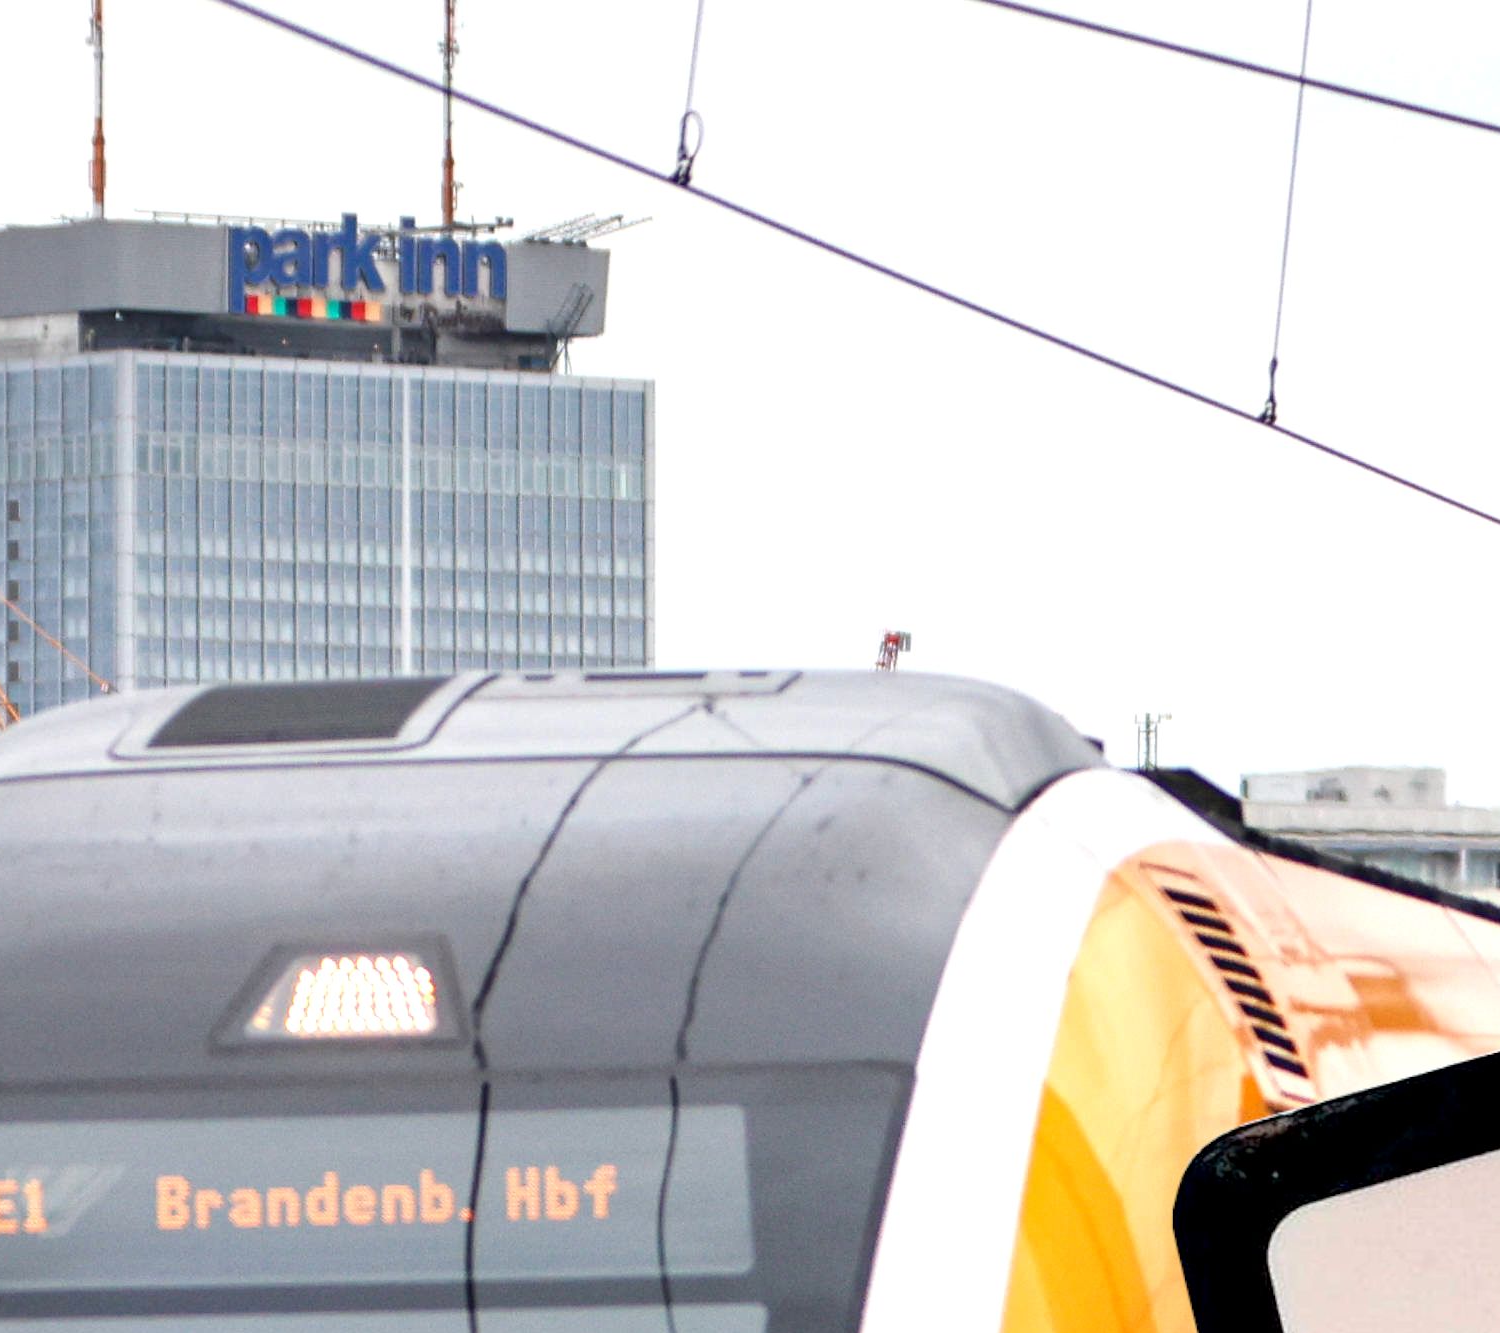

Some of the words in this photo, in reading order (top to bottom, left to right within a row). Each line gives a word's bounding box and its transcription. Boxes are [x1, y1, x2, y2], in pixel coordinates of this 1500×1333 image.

[228, 213, 385, 314] park
[400, 216, 507, 298] inn
[156, 1168, 476, 1231] Brandenb.
[505, 1164, 618, 1222] Hbf
